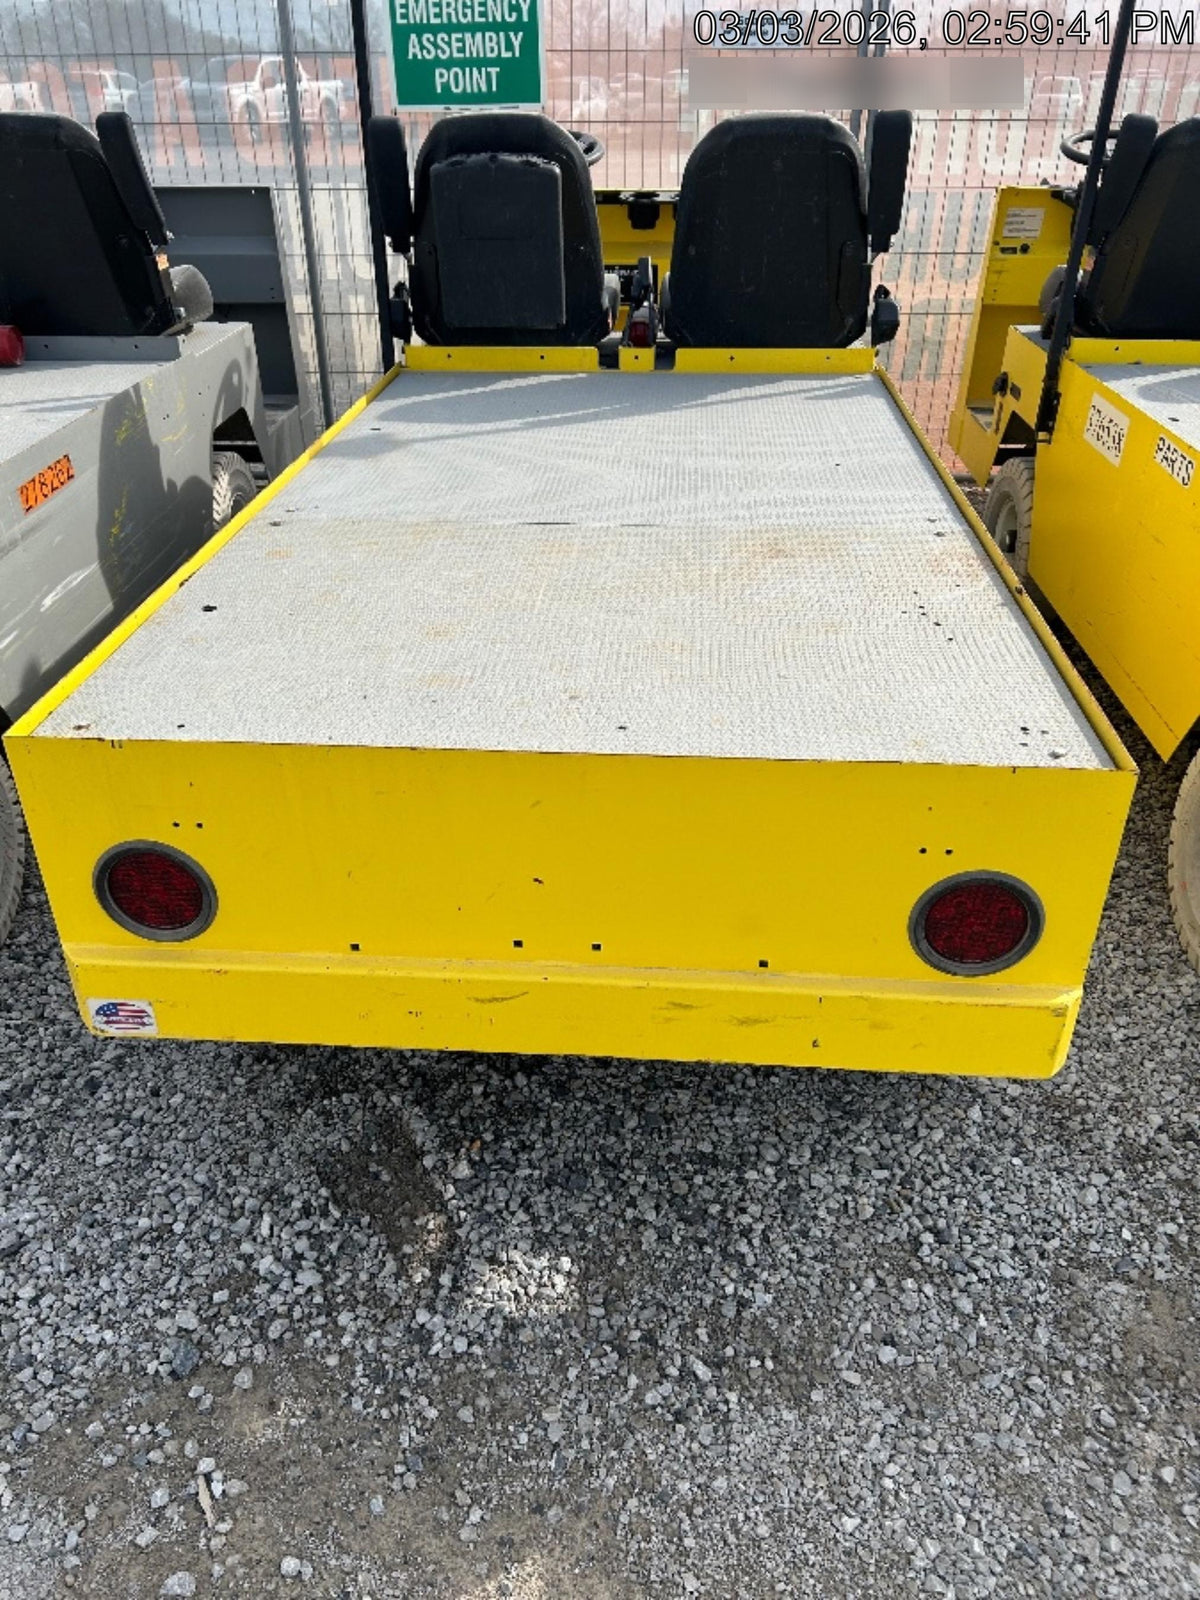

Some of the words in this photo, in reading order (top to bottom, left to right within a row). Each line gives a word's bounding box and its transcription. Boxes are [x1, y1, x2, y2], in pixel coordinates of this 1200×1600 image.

[394, 0, 531, 24] EMERGENCY
[407, 31, 523, 59] ASSEMBLY
[434, 67, 500, 94] POINT
[1153, 436, 1195, 487] PARTS
